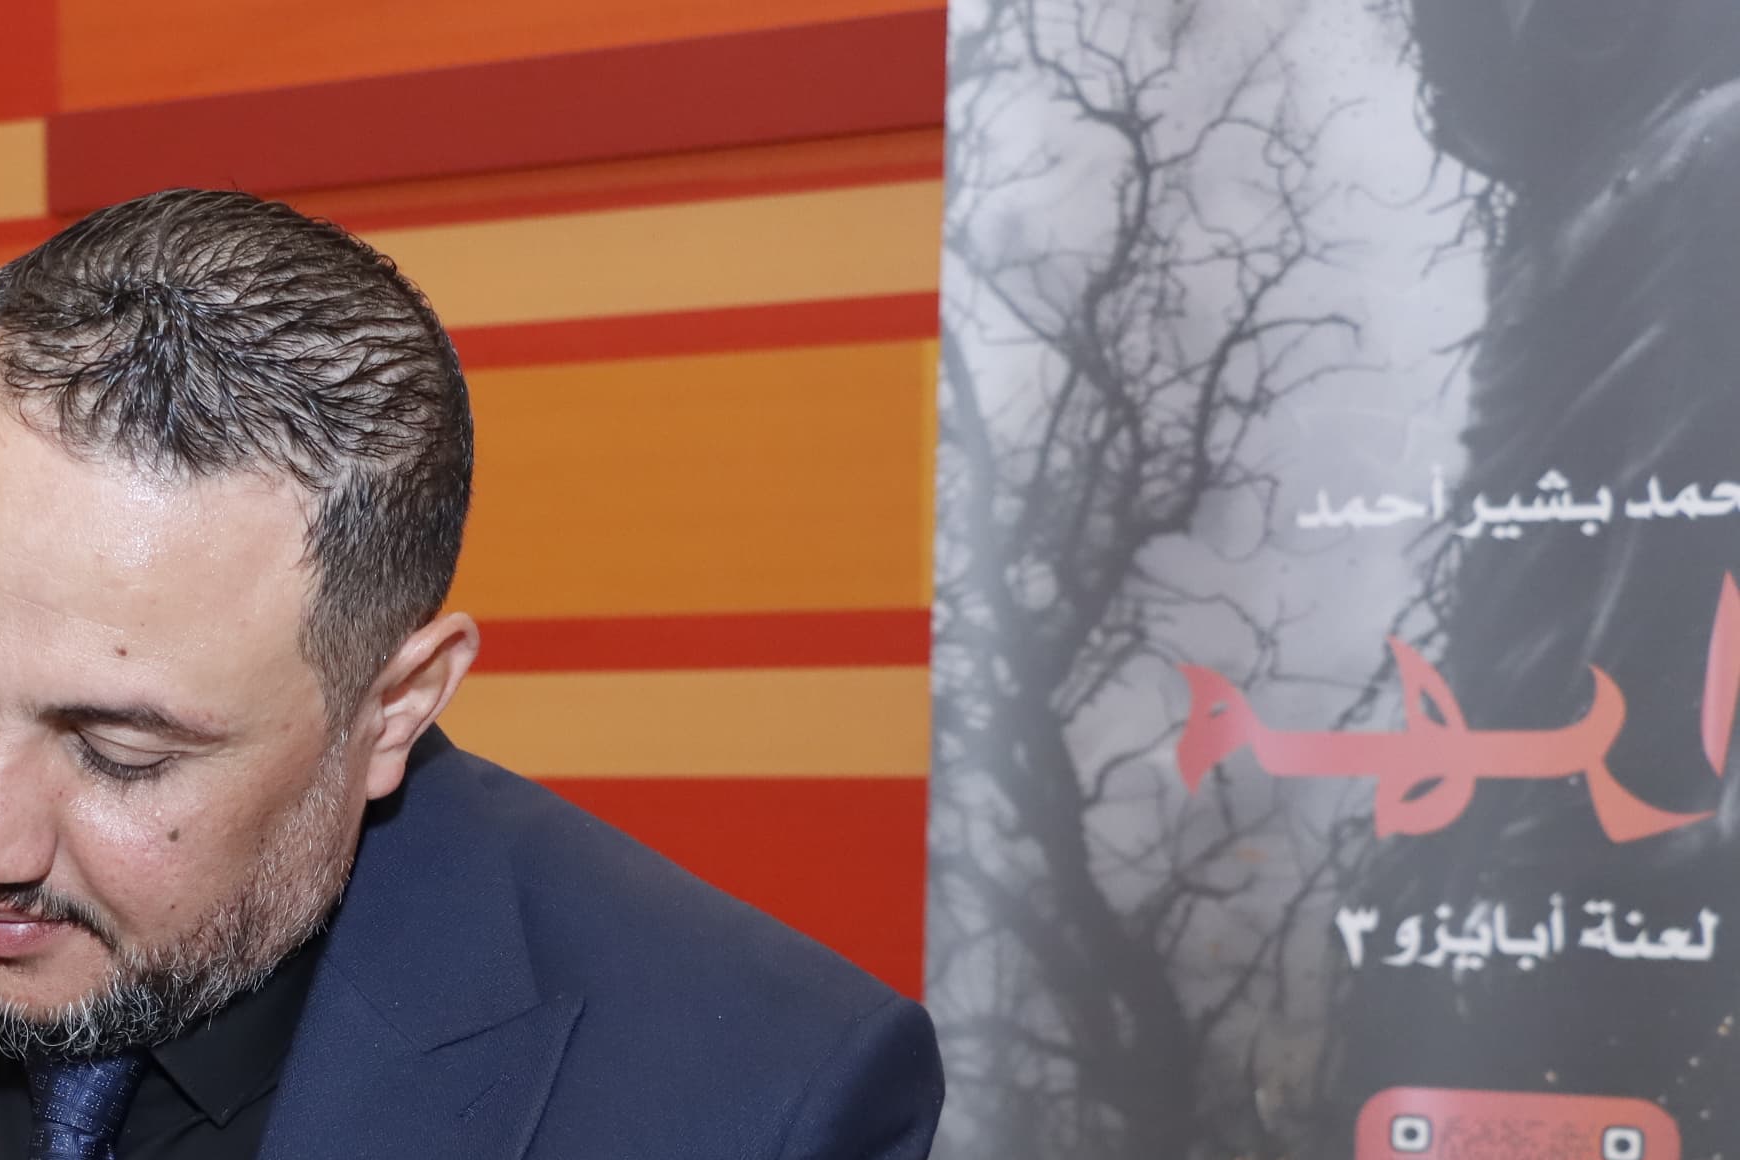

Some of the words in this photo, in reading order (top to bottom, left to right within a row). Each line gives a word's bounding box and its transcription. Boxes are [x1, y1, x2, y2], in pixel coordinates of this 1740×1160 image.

[1454, 469, 1612, 539] بشير
[1625, 475, 1740, 520] حمد
[1336, 905, 1379, 968] ٣
[1579, 900, 1719, 961] لعنة
